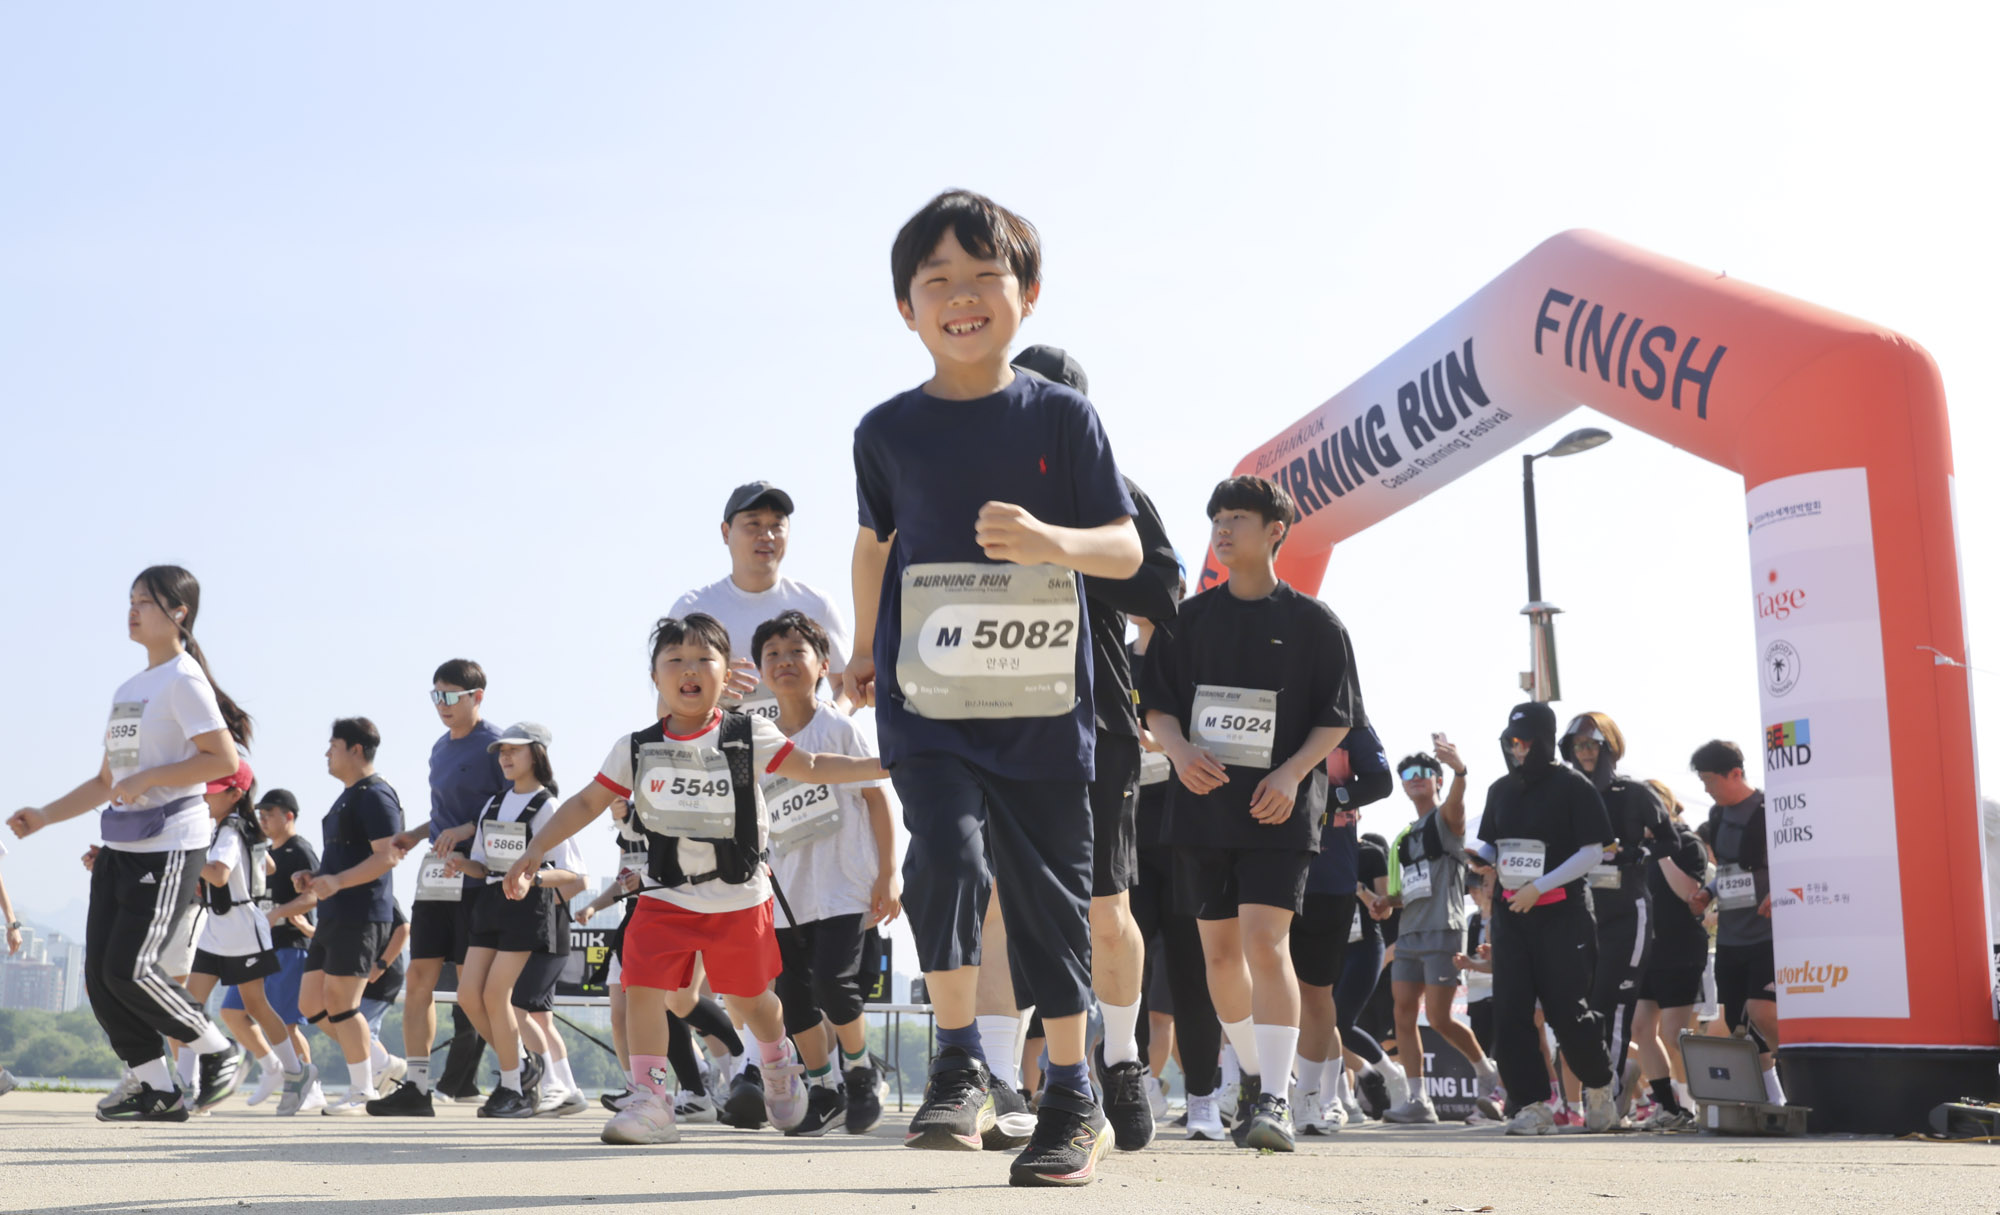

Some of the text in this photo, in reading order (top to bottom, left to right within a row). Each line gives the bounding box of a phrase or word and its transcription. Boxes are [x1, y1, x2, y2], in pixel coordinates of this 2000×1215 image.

[1535, 288, 1728, 420] FINISH
[1271, 336, 1491, 526] URNING RUN
[1380, 407, 1514, 490] Casual Running Festival
[913, 574, 976, 588] BURNING
[978, 574, 1012, 588] RUN
[935, 618, 1075, 650] M 5082
[112, 725, 137, 739] 5595
[1205, 715, 1272, 734] M 5024
[1767, 743, 1812, 772] KIND
[650, 776, 730, 798] W 5549
[771, 811, 781, 825] M
[782, 783, 830, 818] 5023
[1772, 793, 1807, 814] TOUS
[494, 839, 523, 850] 5866
[1773, 825, 1813, 850] JOURS
[1510, 857, 1542, 868] 5626
[431, 867, 463, 880] 522
[1726, 877, 1751, 889] 5298
